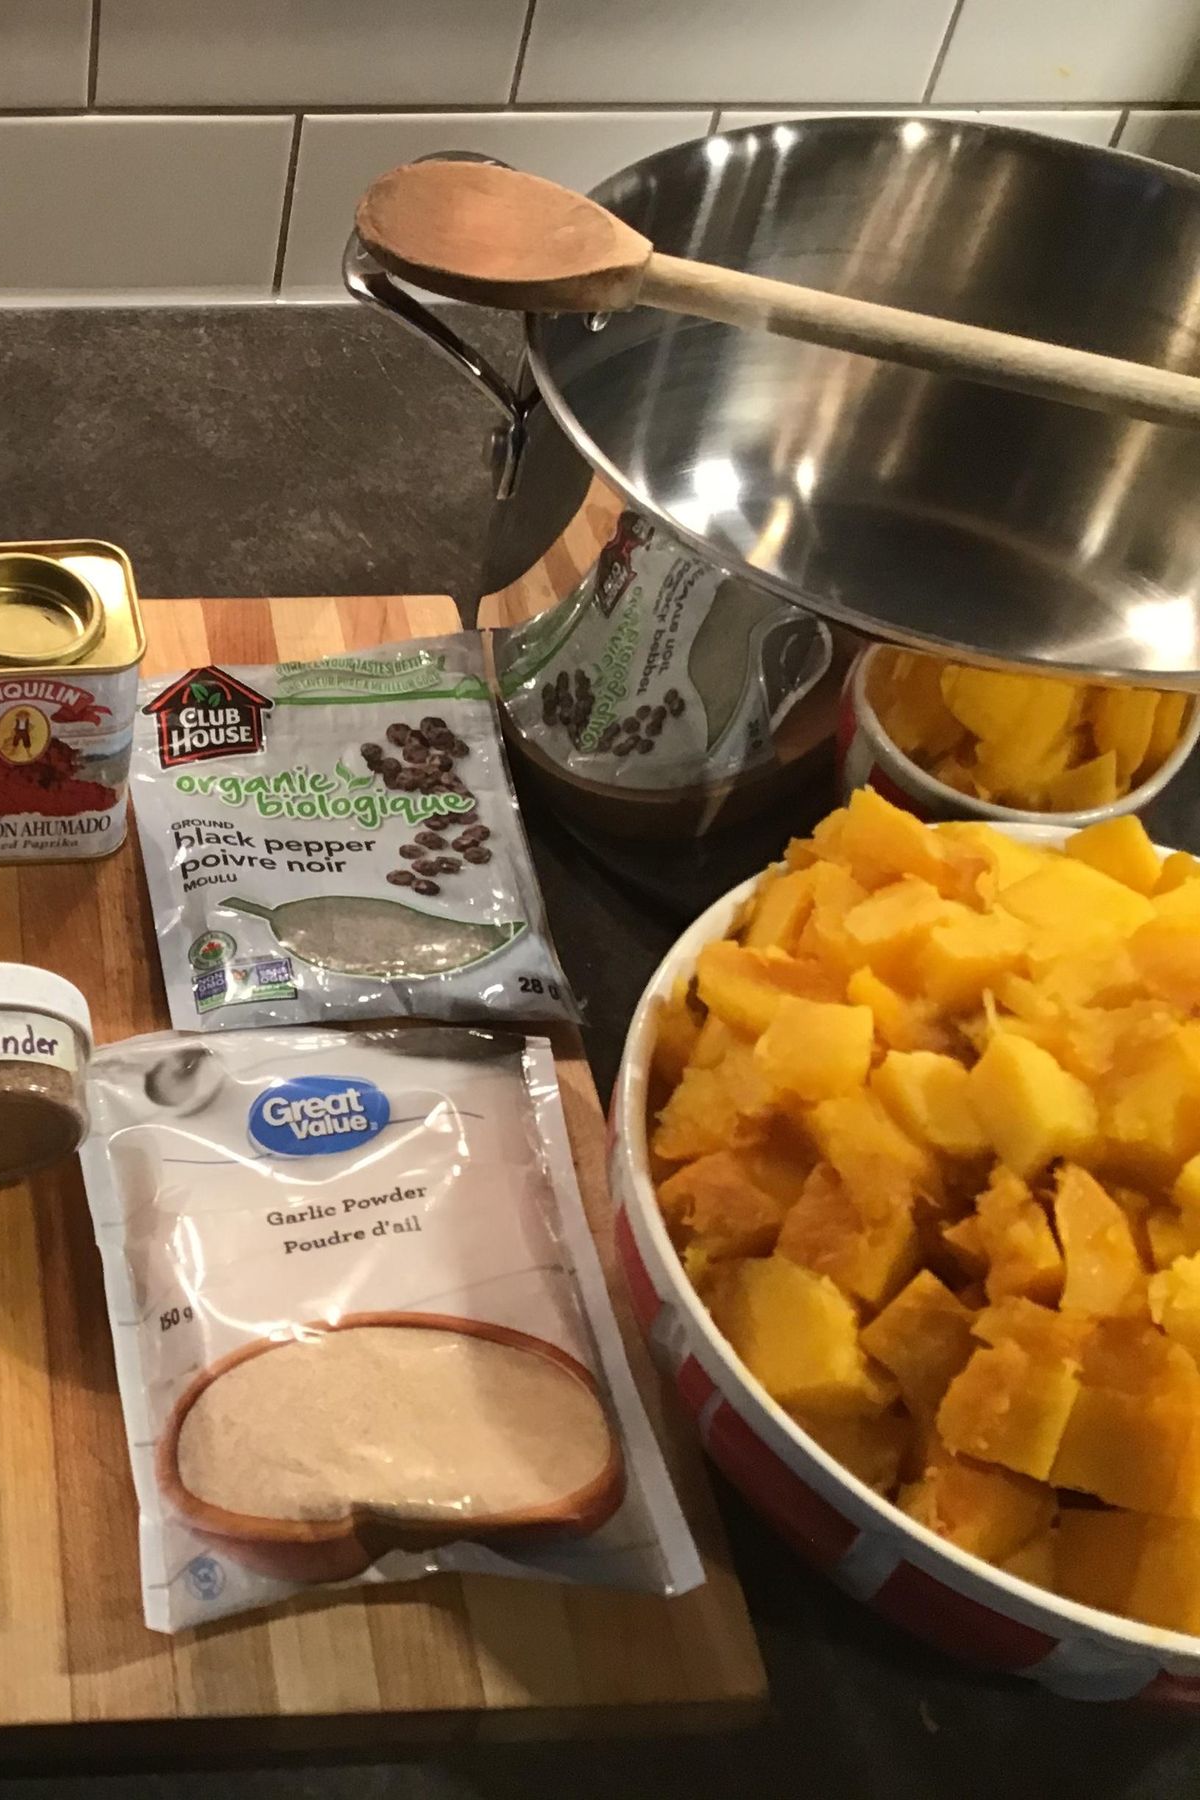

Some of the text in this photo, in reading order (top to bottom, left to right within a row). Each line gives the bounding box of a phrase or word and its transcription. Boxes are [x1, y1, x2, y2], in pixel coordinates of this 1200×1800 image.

[179, 707, 241, 728] CLUB
[171, 725, 253, 757] HOUSE
[175, 766, 338, 806] organic
[256, 788, 476, 829] biologique
[20, 814, 112, 838] AHUMADO
[170, 818, 234, 830] GROUND
[22, 838, 79, 850] Paprika
[174, 827, 377, 857] black pepper
[180, 849, 347, 879] poivre noir
[183, 873, 238, 893] MOULU
[518, 976, 545, 994] 28
[262, 1088, 365, 1127] Great
[290, 1115, 368, 1140] Value
[266, 1186, 427, 1226] Garlic Powder
[283, 1215, 422, 1255] Poudre d'ail
[160, 1307, 180, 1332] 150
